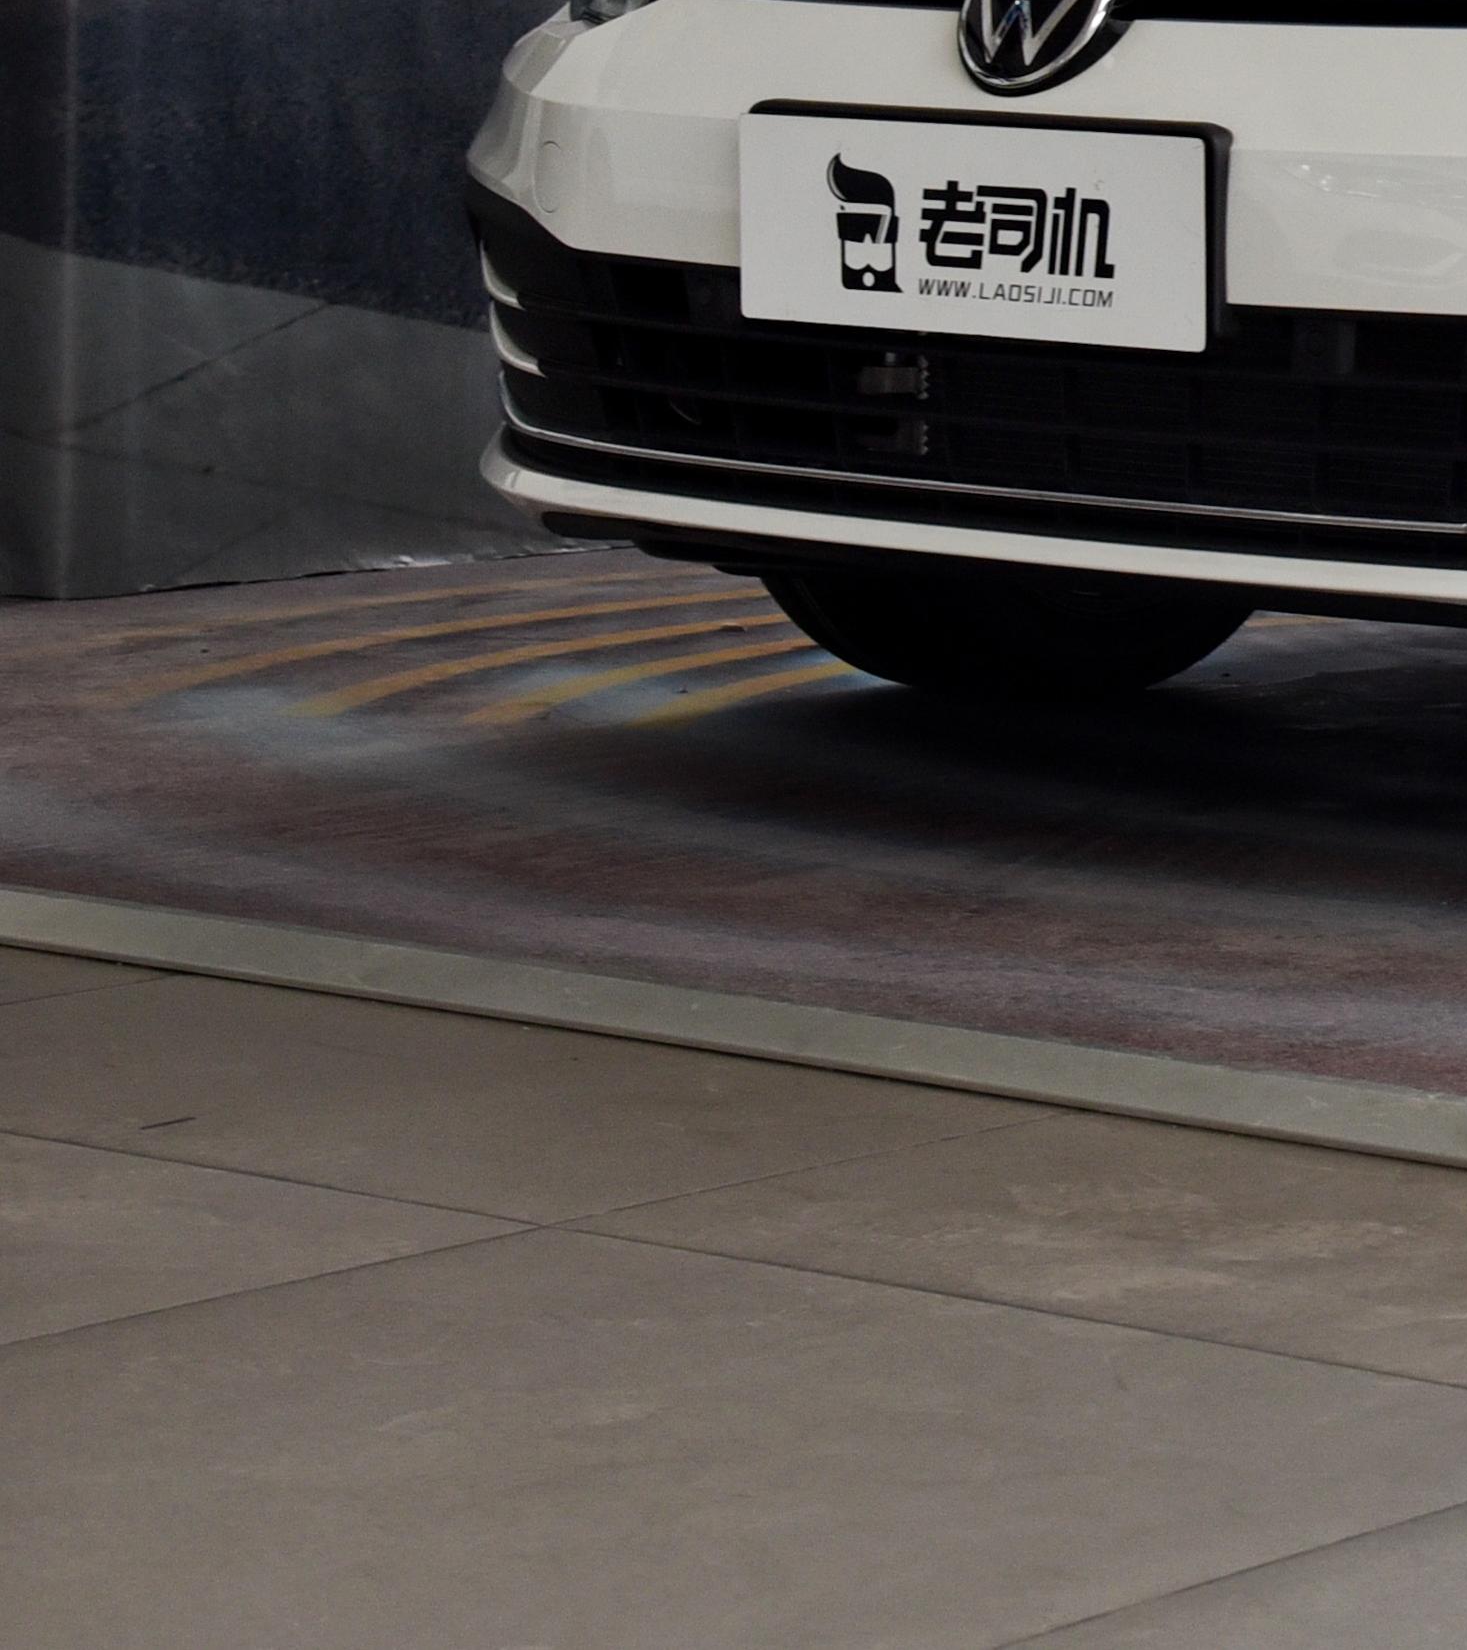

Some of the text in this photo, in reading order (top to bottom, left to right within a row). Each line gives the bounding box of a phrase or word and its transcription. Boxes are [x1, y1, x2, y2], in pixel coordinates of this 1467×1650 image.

[918, 180, 1115, 278] 老司机
[918, 278, 1114, 308] WWW.LAOSIJI.COM
